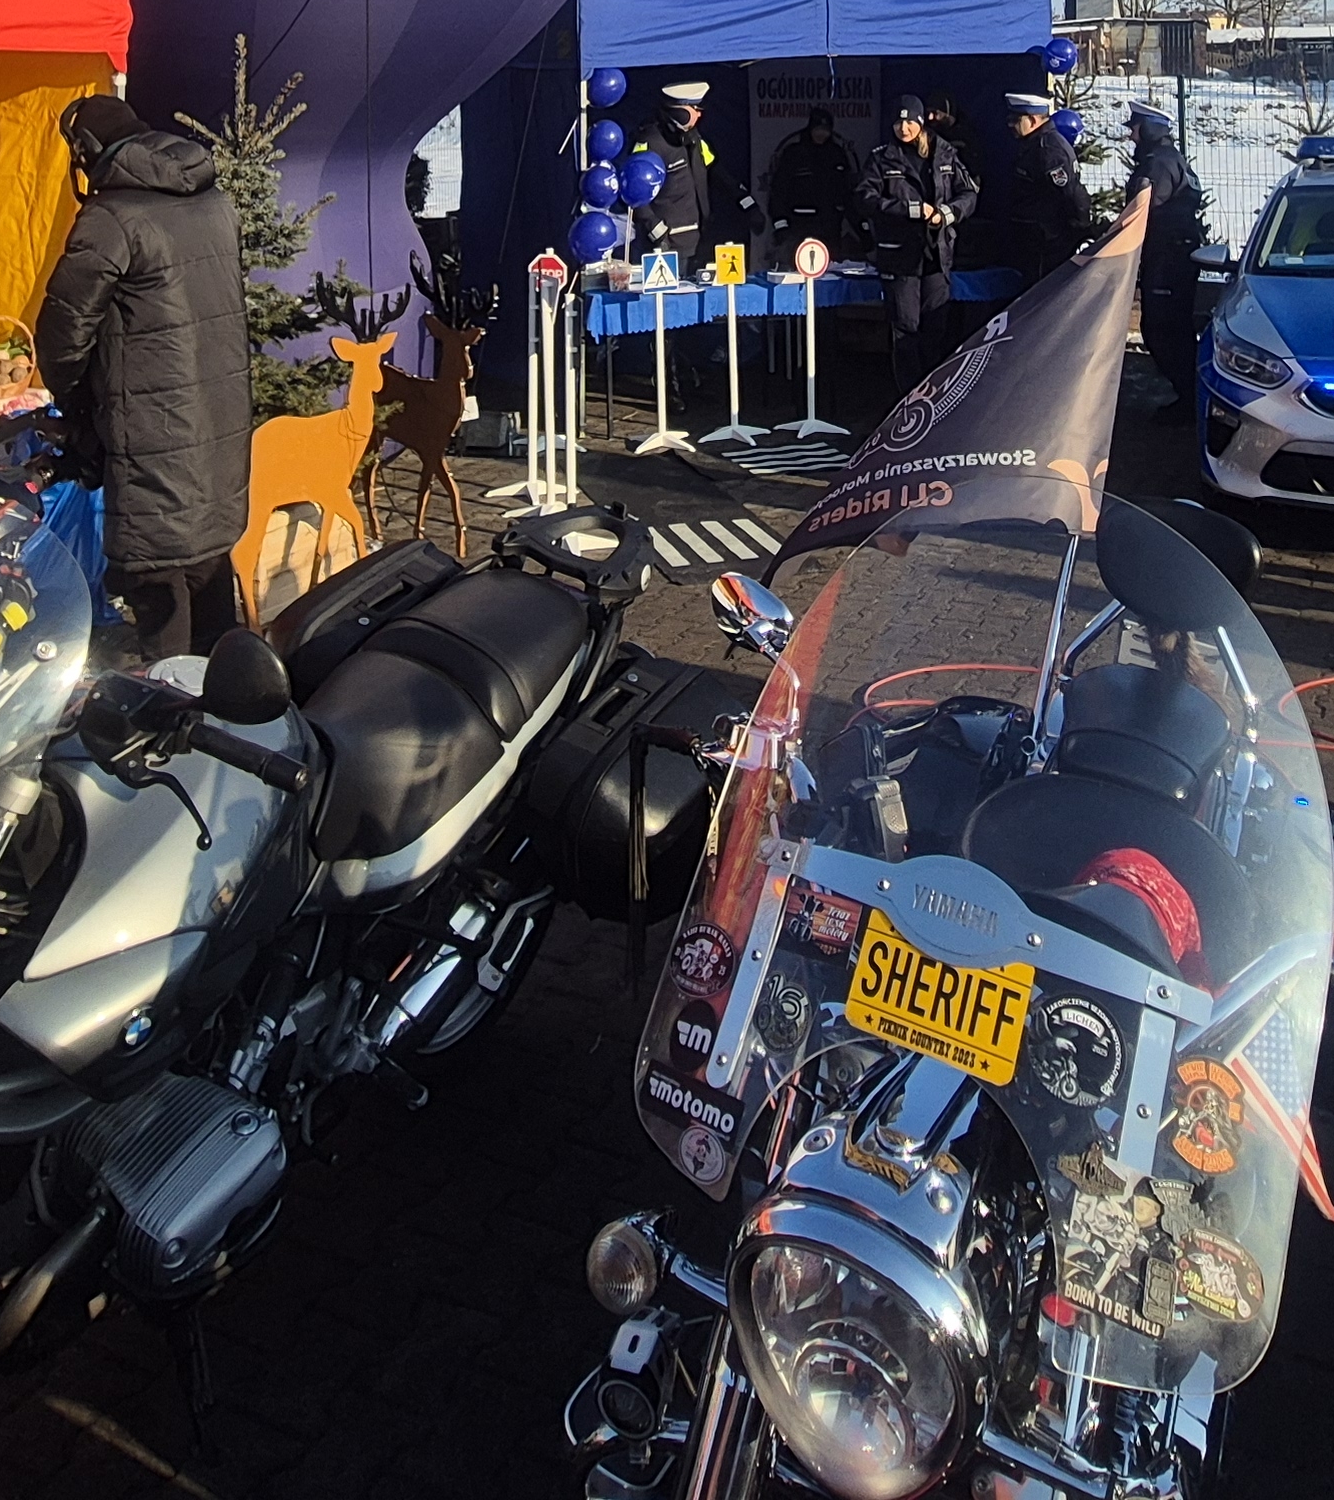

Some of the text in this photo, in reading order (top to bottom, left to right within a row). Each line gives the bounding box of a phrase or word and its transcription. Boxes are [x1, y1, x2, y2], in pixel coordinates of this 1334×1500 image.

[912, 883, 999, 938] YAMAHA
[860, 940, 1022, 1047] SHERIFF
[877, 1016, 977, 1069] PIKNIK COUNTRY 2023
[651, 1077, 735, 1134] motomo
[1064, 1282, 1096, 1310] BORN
[1097, 1294, 1115, 1316] TO
[1113, 1303, 1131, 1324] BE
